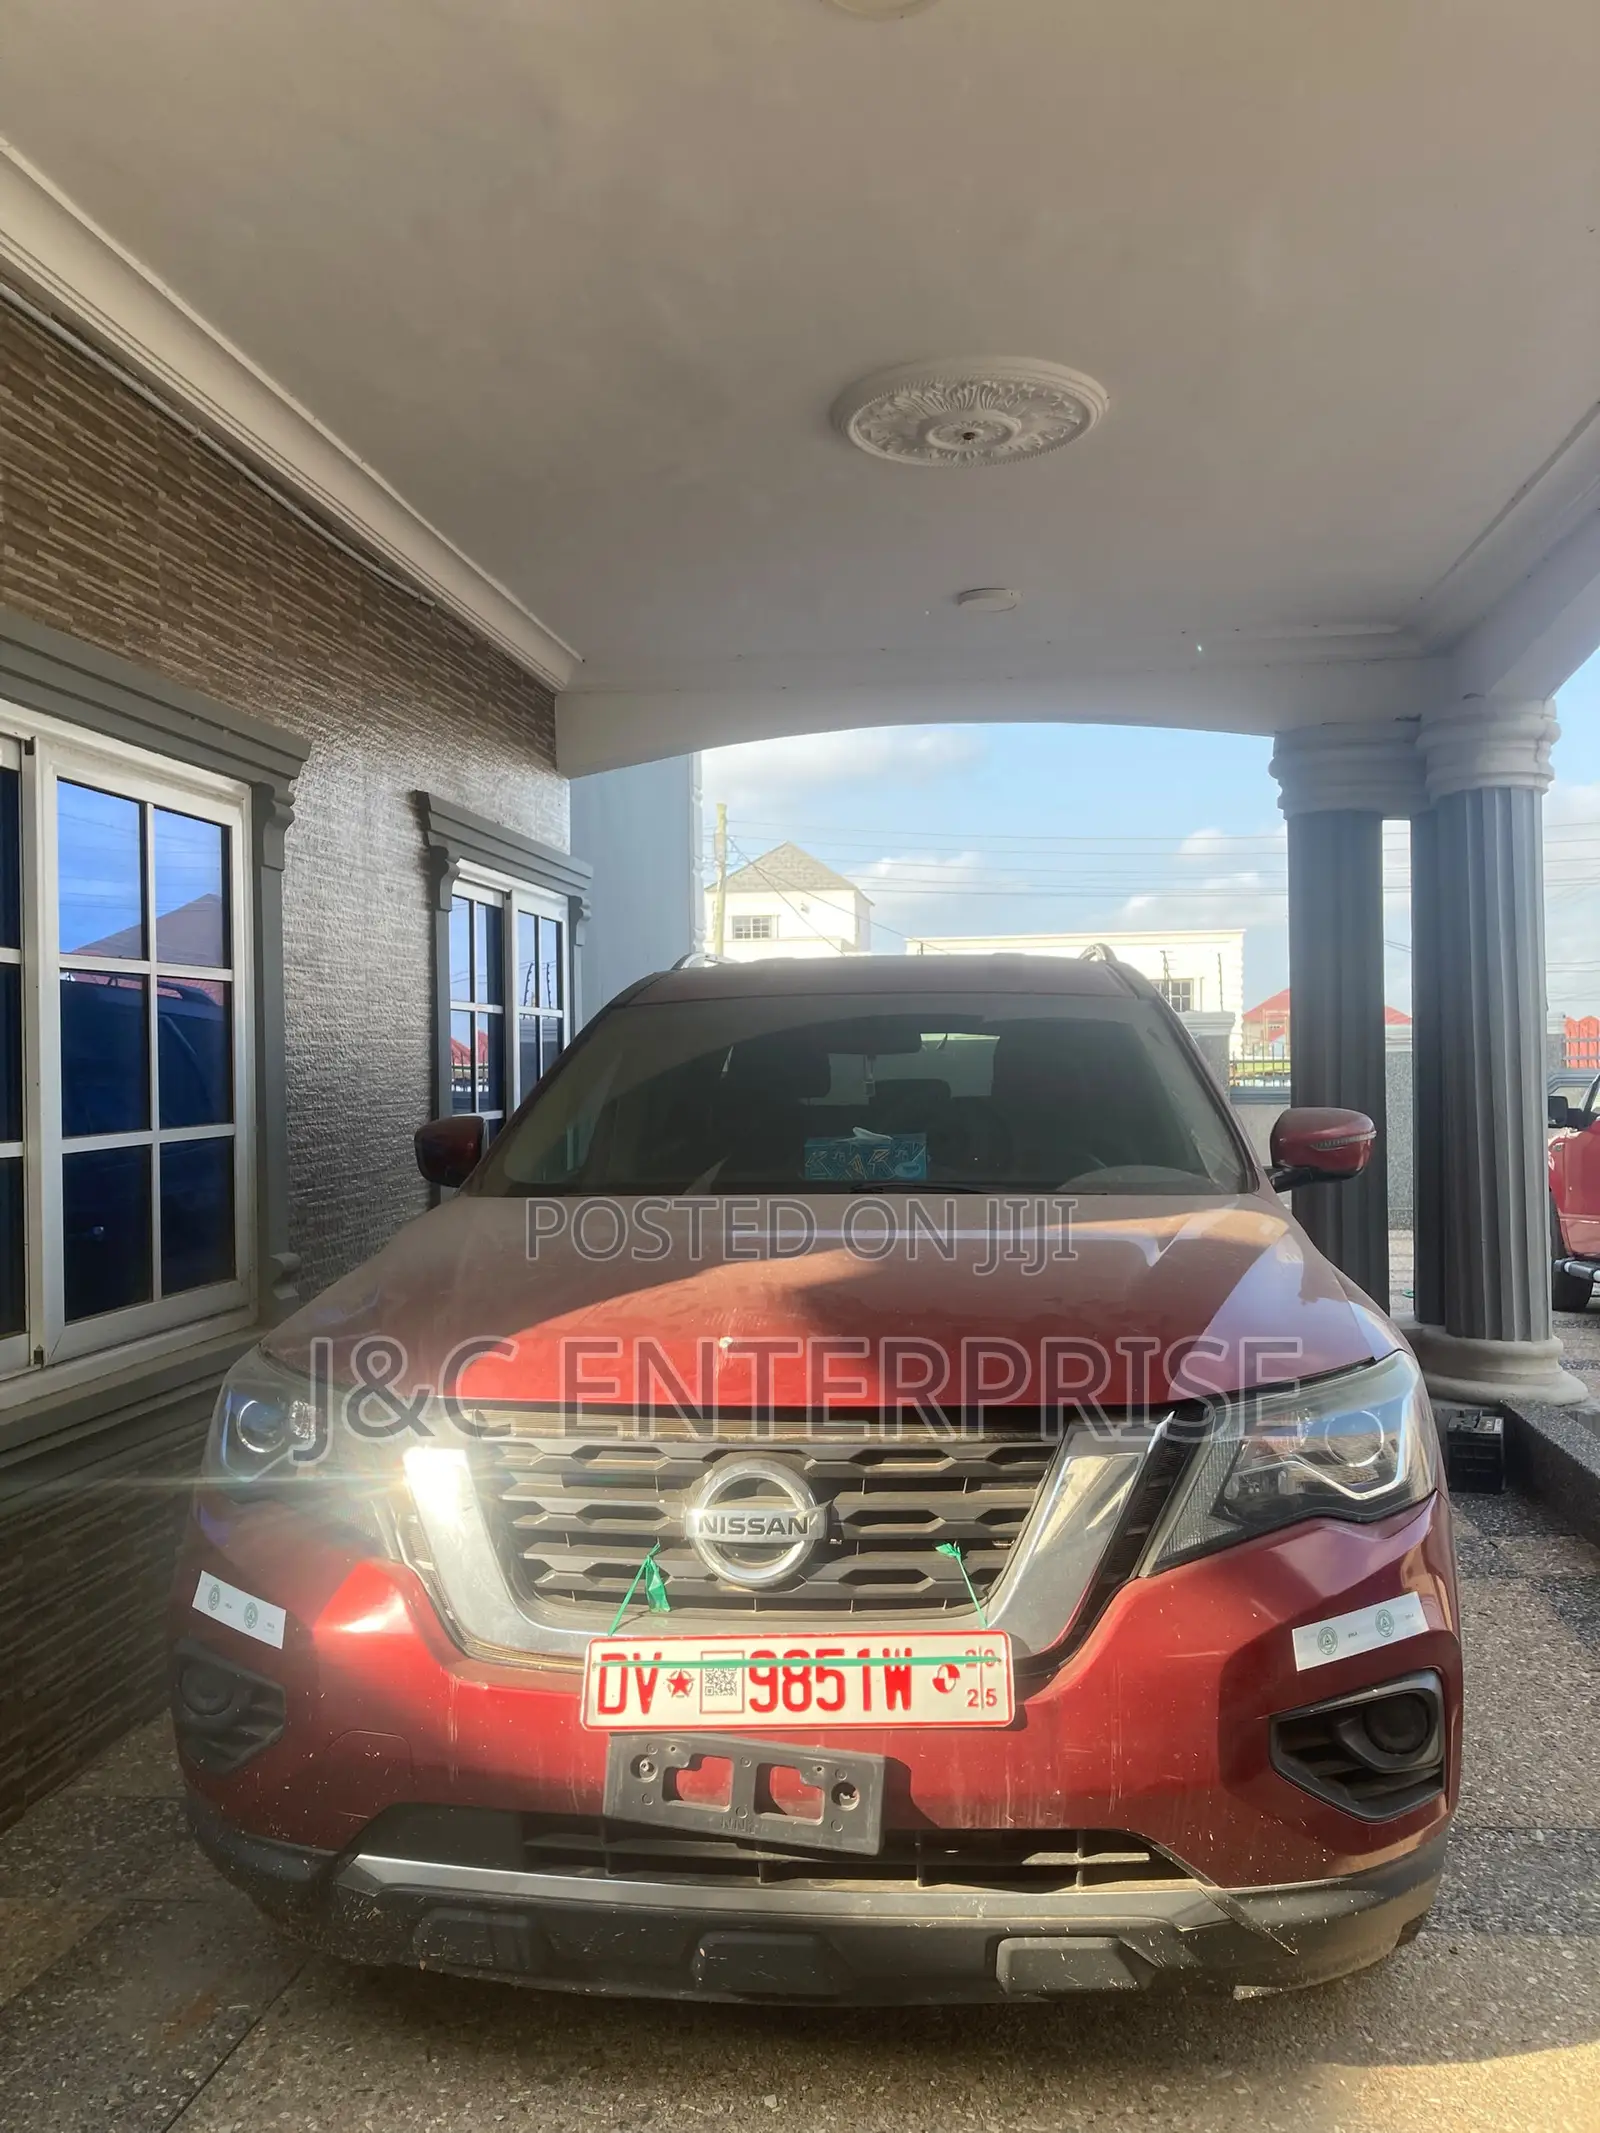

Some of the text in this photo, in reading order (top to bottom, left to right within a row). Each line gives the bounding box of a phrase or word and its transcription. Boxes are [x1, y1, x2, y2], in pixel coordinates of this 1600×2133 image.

[698, 1516, 809, 1536] NISSAN
[597, 1651, 663, 1716] DV
[966, 1687, 998, 1708] 25
